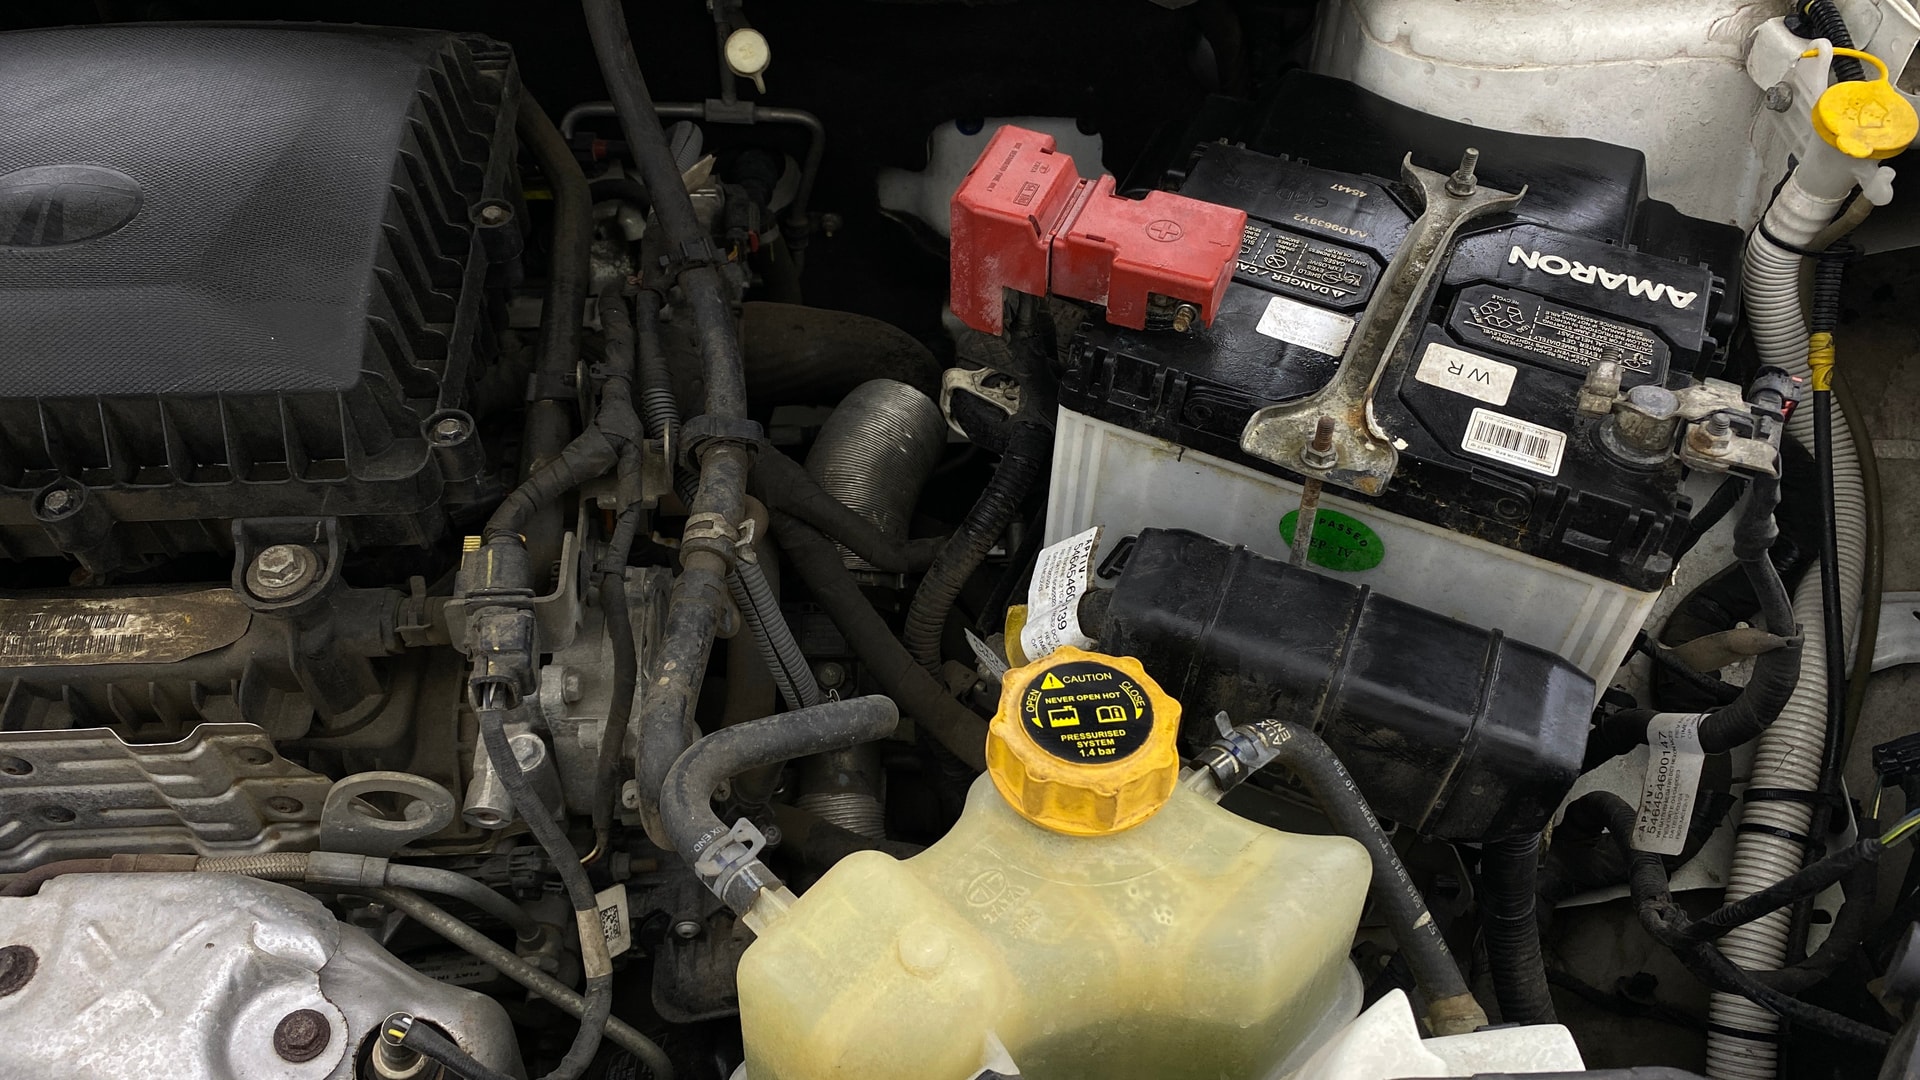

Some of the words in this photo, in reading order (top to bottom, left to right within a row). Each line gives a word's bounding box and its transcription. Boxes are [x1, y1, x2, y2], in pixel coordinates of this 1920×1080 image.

[1271, 272, 1329, 294] DANGER
[1508, 245, 1697, 309] AMARON
[1533, 334, 1578, 352] IMMEDIATELY
[1561, 336, 1576, 345] GET
[1062, 672, 1112, 684] CAUTION
[1025, 688, 1039, 712] OPEN
[1045, 695, 1074, 704] NEVER
[1076, 693, 1101, 702] OPEN
[1103, 691, 1120, 699] HOT
[1121, 681, 1145, 708] CLOSE
[1060, 729, 1126, 741] PRESSURISED
[1076, 738, 1115, 748] SYSTEM
[1079, 749, 1095, 757] 1.4
[1098, 747, 1116, 756] bar
[1647, 731, 1671, 833] 546454600147
